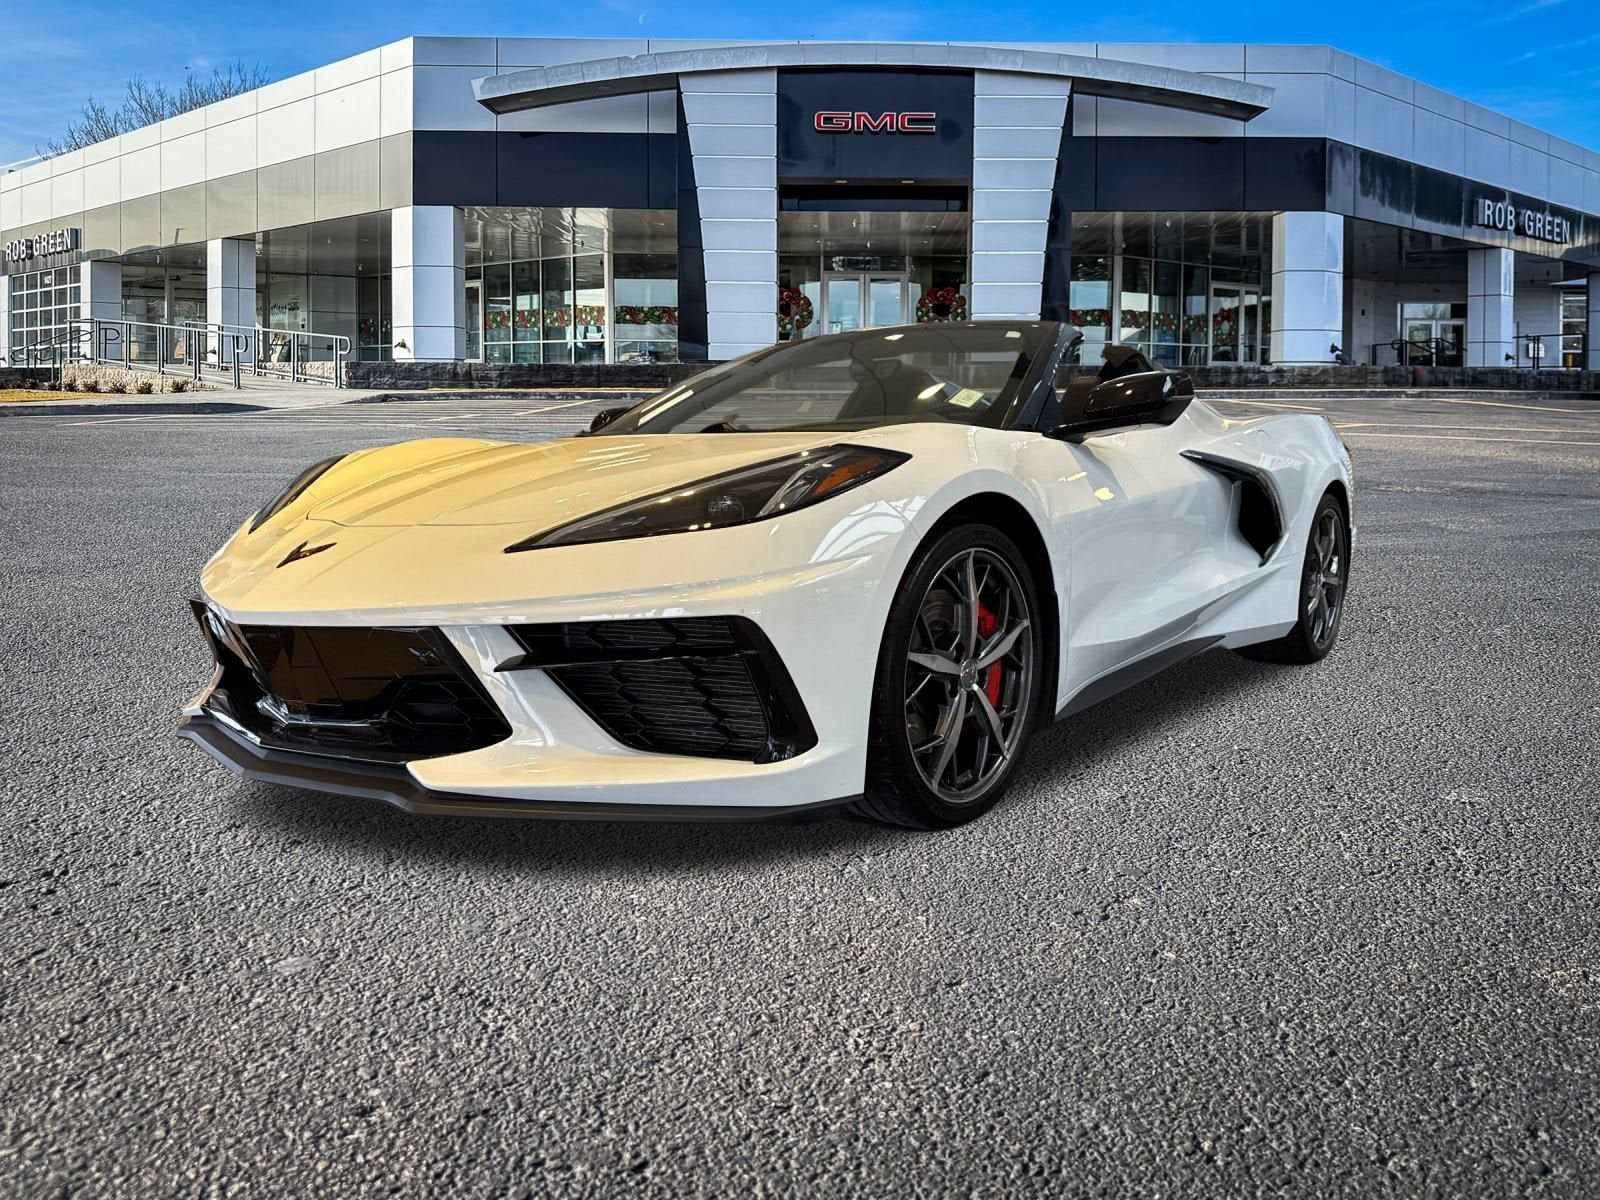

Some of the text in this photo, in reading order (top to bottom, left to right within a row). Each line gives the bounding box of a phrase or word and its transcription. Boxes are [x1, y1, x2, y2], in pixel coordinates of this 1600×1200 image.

[814, 111, 936, 132] GMC
[1484, 199, 1570, 243] ROB GREEN
[5, 228, 71, 261] ROB GREEN
